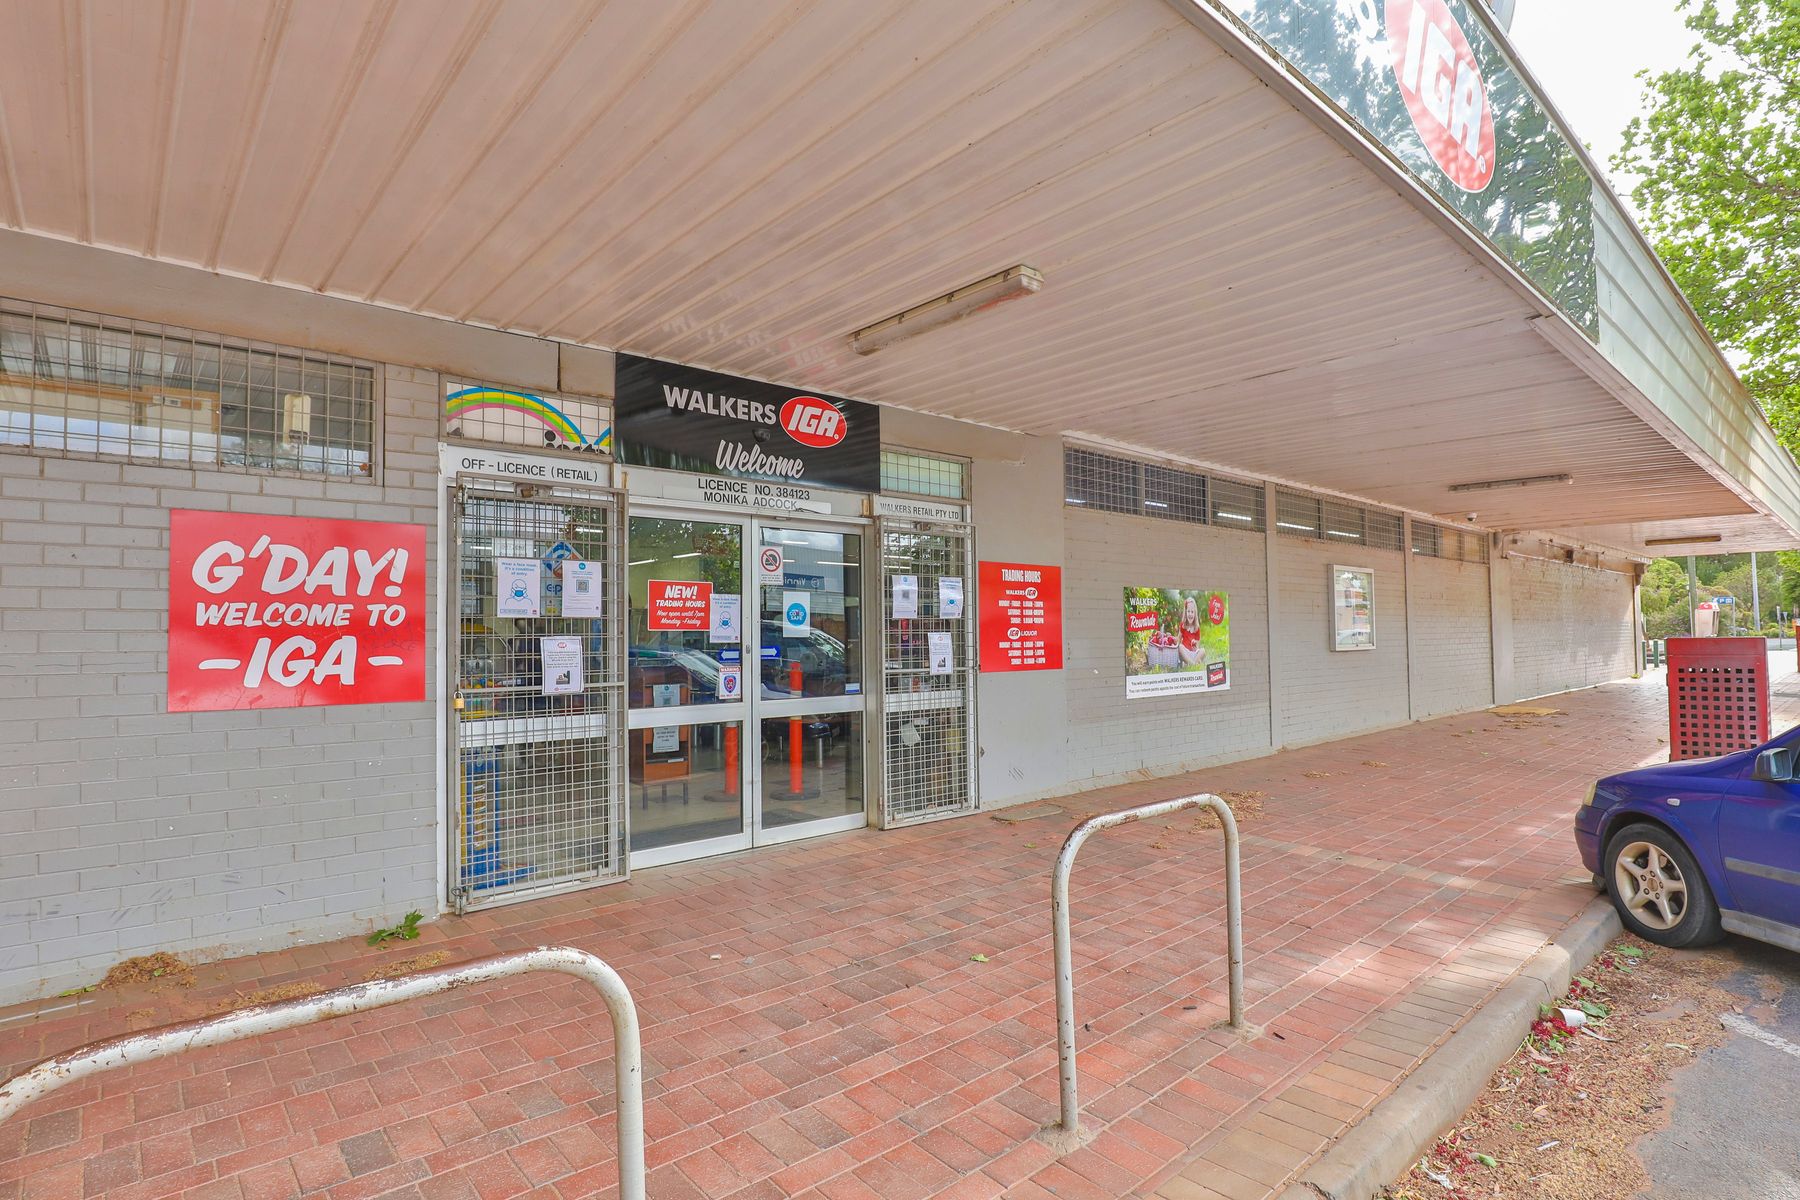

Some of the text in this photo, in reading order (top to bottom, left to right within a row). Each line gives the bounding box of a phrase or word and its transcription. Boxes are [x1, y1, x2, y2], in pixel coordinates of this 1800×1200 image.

[1402, 1, 1484, 160] IGA
[662, 384, 840, 439] WALKERS IGA
[461, 457, 486, 470] OFF
[497, 461, 546, 477] LICENCE
[715, 438, 805, 480] Welcome
[698, 478, 748, 494] LICENCE
[704, 491, 797, 510] MONIKA ADCOCK
[880, 502, 959, 520] WALKERS RETAIL PTY LTD
[191, 534, 409, 598] G'DAY!
[1001, 569, 1041, 583] TRADING HOURS
[664, 584, 698, 600] NEW!
[655, 599, 683, 608] TRADING
[685, 600, 706, 609] HOURS
[1129, 597, 1158, 607] WALKERS
[195, 601, 406, 628] WELCOME TO
[1130, 614, 1156, 629] Rewards
